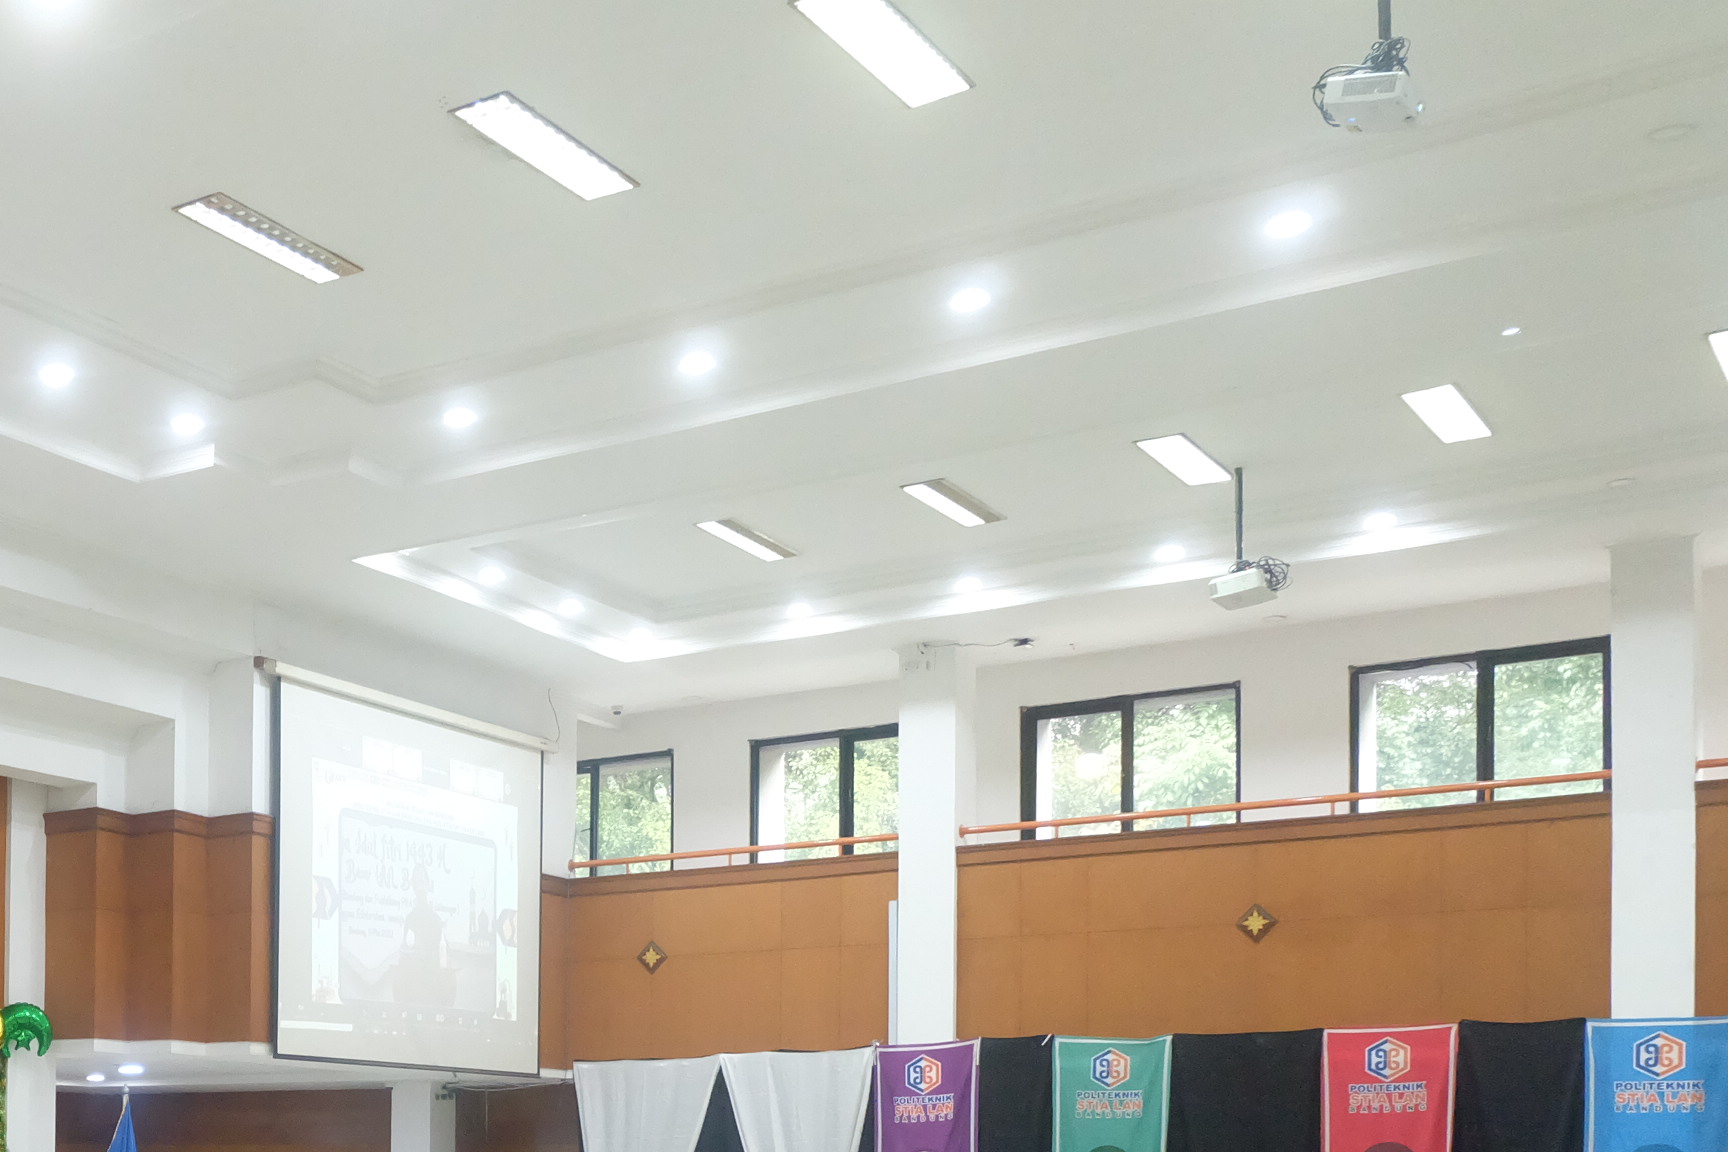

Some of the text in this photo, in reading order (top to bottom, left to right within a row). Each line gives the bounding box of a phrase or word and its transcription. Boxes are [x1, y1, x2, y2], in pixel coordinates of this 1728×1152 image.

[1349, 1081, 1426, 1093] POLITEKNIK
[1614, 1080, 1705, 1092] POLITEKNIK
[893, 1094, 954, 1105] POLITEKNIK
[1076, 1090, 1143, 1100] POLITEKNIK
[1349, 1091, 1427, 1106] STIA LAN
[1615, 1091, 1706, 1105] STIA LAN
[895, 1102, 954, 1116] STIA LAN
[1077, 1100, 1143, 1112] STIA LAN
[1349, 1103, 1427, 1114] BANDUNG
[1614, 1104, 1705, 1113] BANDUNG
